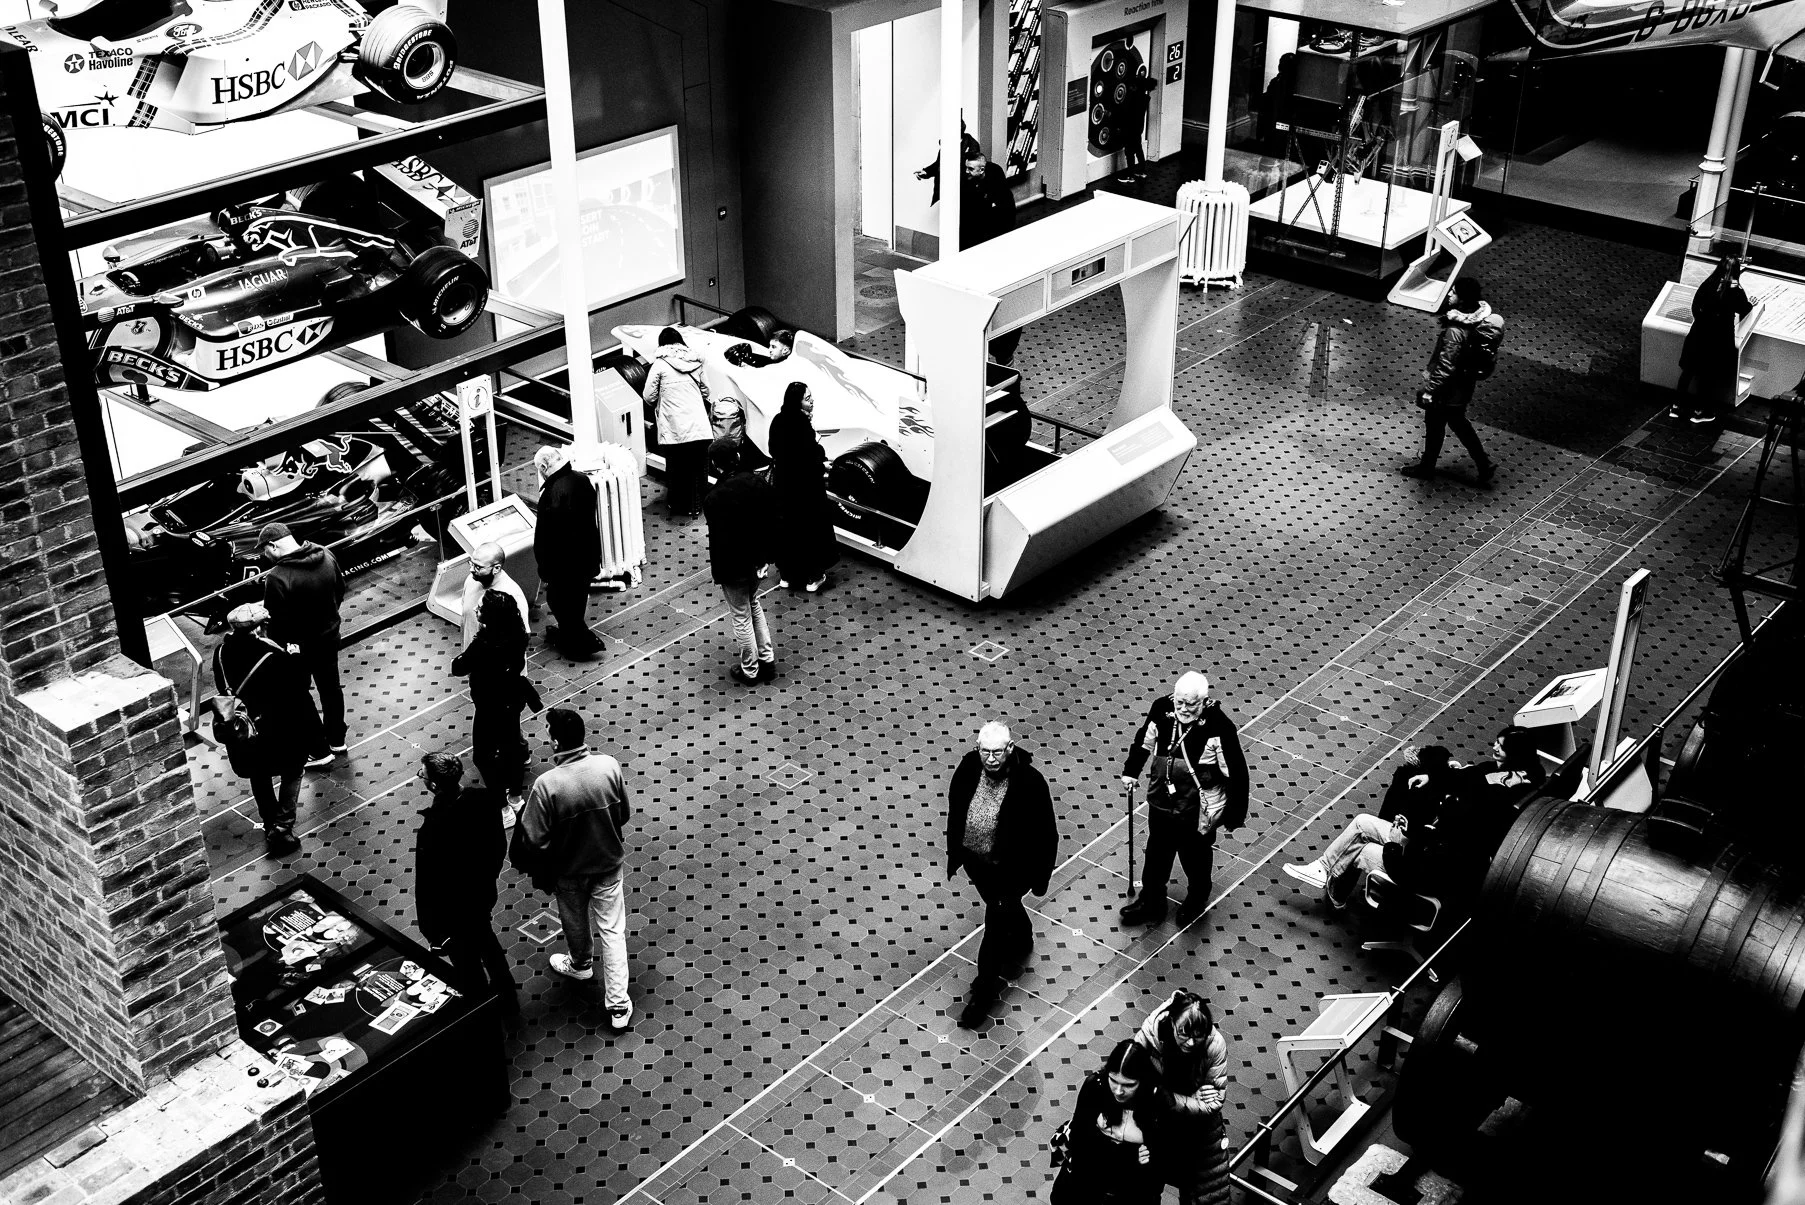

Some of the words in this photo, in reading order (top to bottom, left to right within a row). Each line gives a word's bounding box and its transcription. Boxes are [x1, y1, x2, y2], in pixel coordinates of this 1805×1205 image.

[1124, 2, 1151, 16] Reaction
[172, 25, 197, 37] Ford
[89, 47, 133, 59] TEXACO
[393, 29, 433, 70] BRIDGESTONE
[1169, 44, 1180, 60] 26
[89, 56, 133, 70] Havoline
[1173, 65, 1180, 80] 2
[211, 61, 286, 104] HSBC
[50, 108, 110, 128] MCI
[229, 209, 262, 225] BECK'S
[460, 236, 478, 249] AT&T
[238, 268, 288, 291] JAGUAR
[432, 275, 459, 307] MICHELIN
[116, 304, 136, 316] AT&T
[178, 313, 205, 330] BECK'S
[216, 329, 293, 371] HSBC
[107, 350, 181, 383] BECK'S
